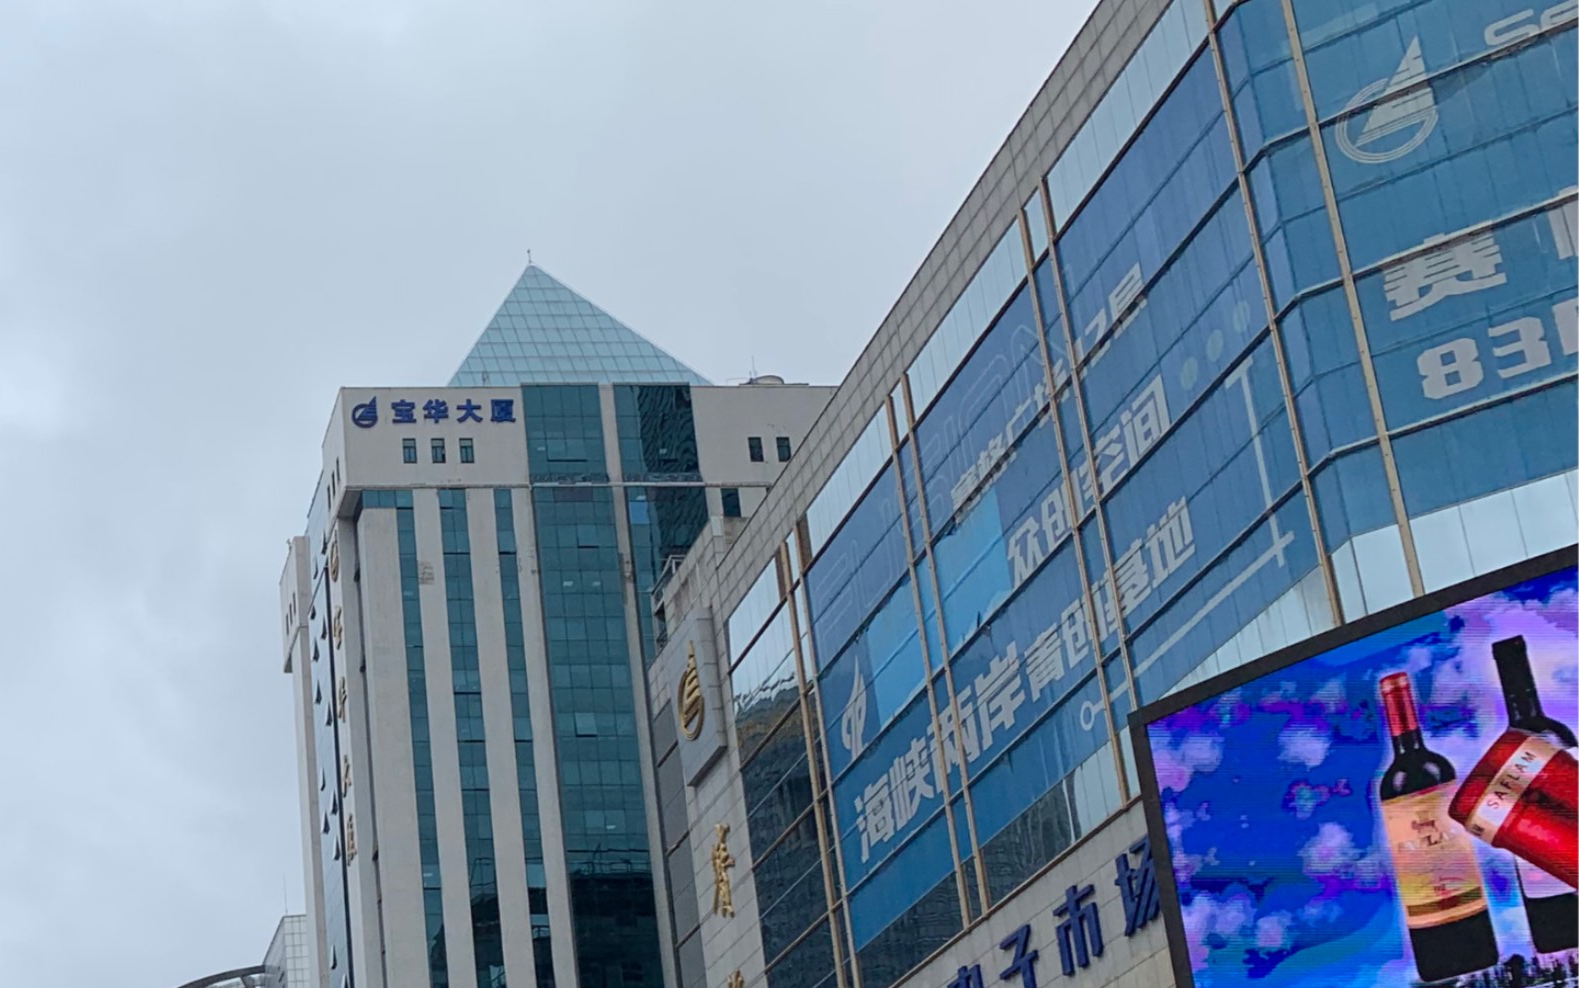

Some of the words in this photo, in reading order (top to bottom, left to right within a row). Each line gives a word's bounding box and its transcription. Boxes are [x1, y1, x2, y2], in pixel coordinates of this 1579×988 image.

[390, 398, 517, 424] 宝华大厦
[1008, 373, 1171, 590] 众创空间
[854, 495, 1196, 863] 海峡两岸青创基地
[1487, 751, 1536, 809] SAFLAM
